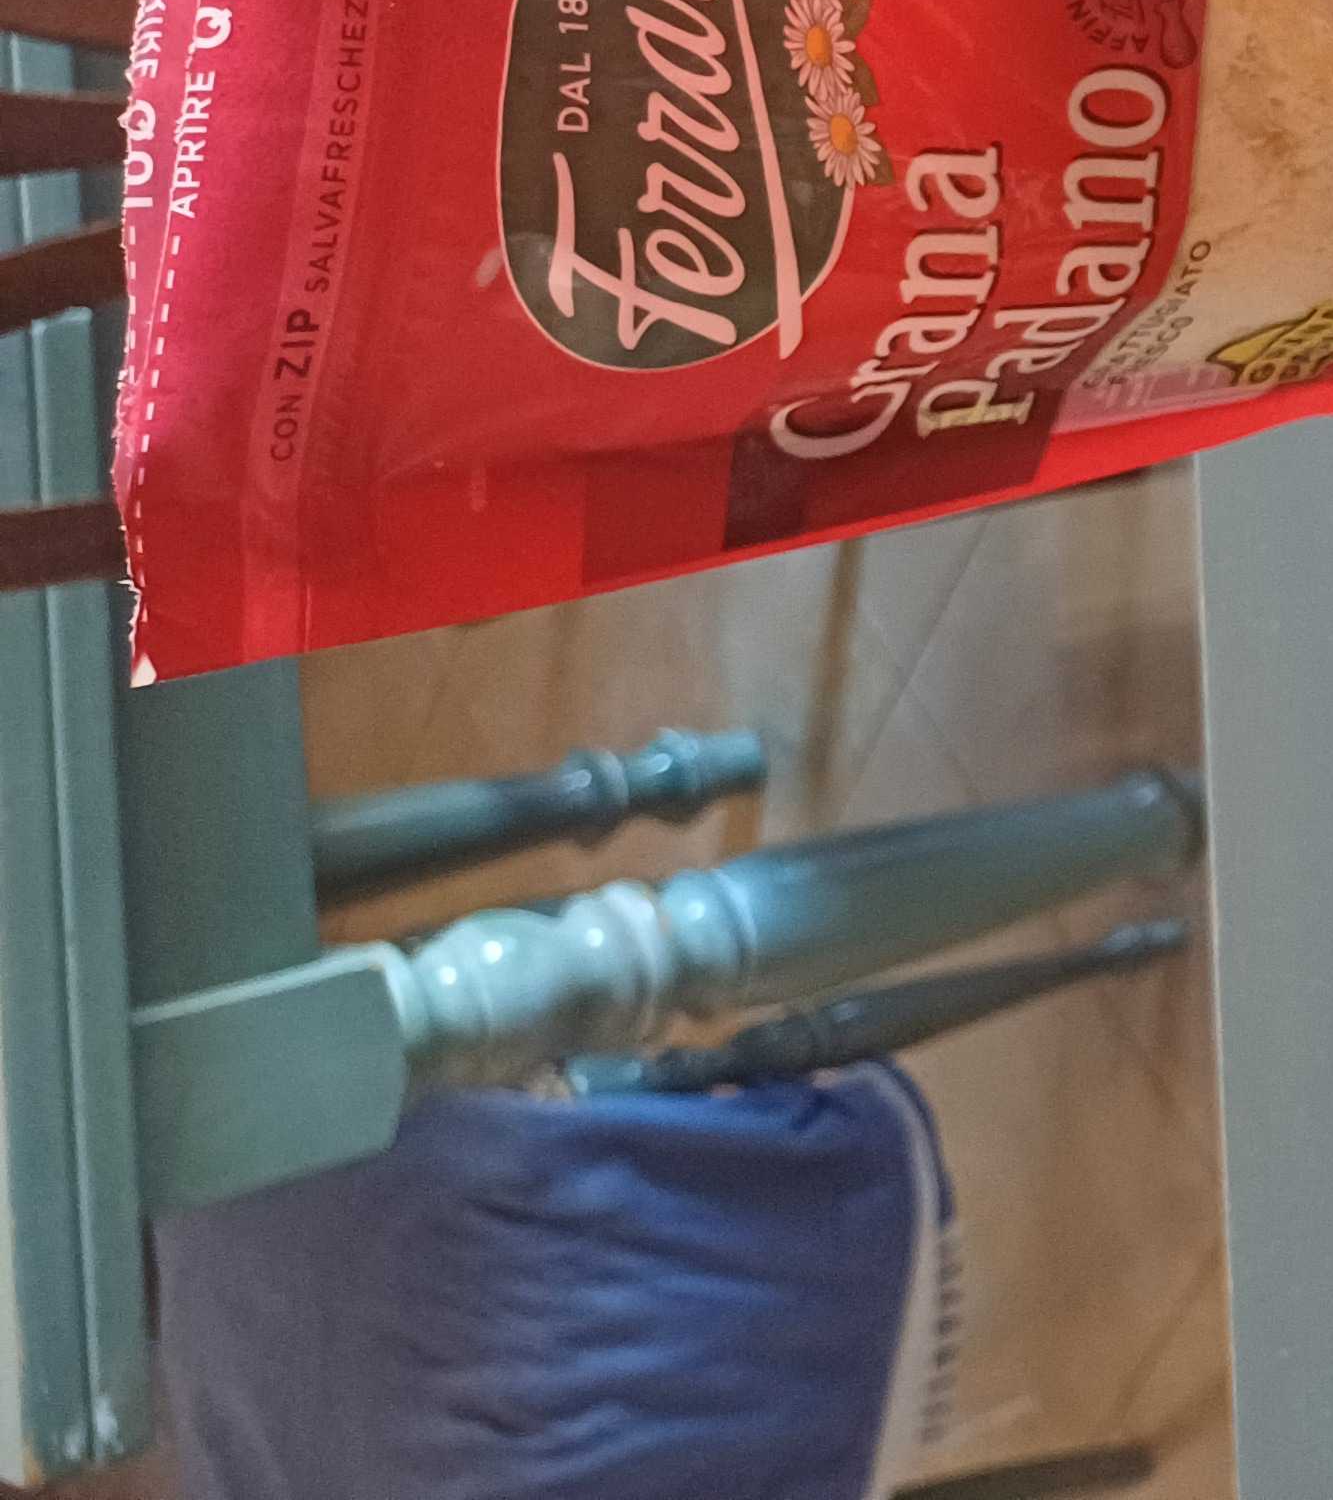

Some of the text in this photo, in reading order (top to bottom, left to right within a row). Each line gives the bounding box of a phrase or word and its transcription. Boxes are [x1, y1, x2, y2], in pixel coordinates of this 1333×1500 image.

[170, 70, 216, 218] APRIRE
[558, 52, 592, 133] DAL
[770, 146, 1001, 460] Grana
[916, 68, 1168, 437] Padano
[273, 308, 319, 381] ZIP
[270, 395, 301, 462] CON
